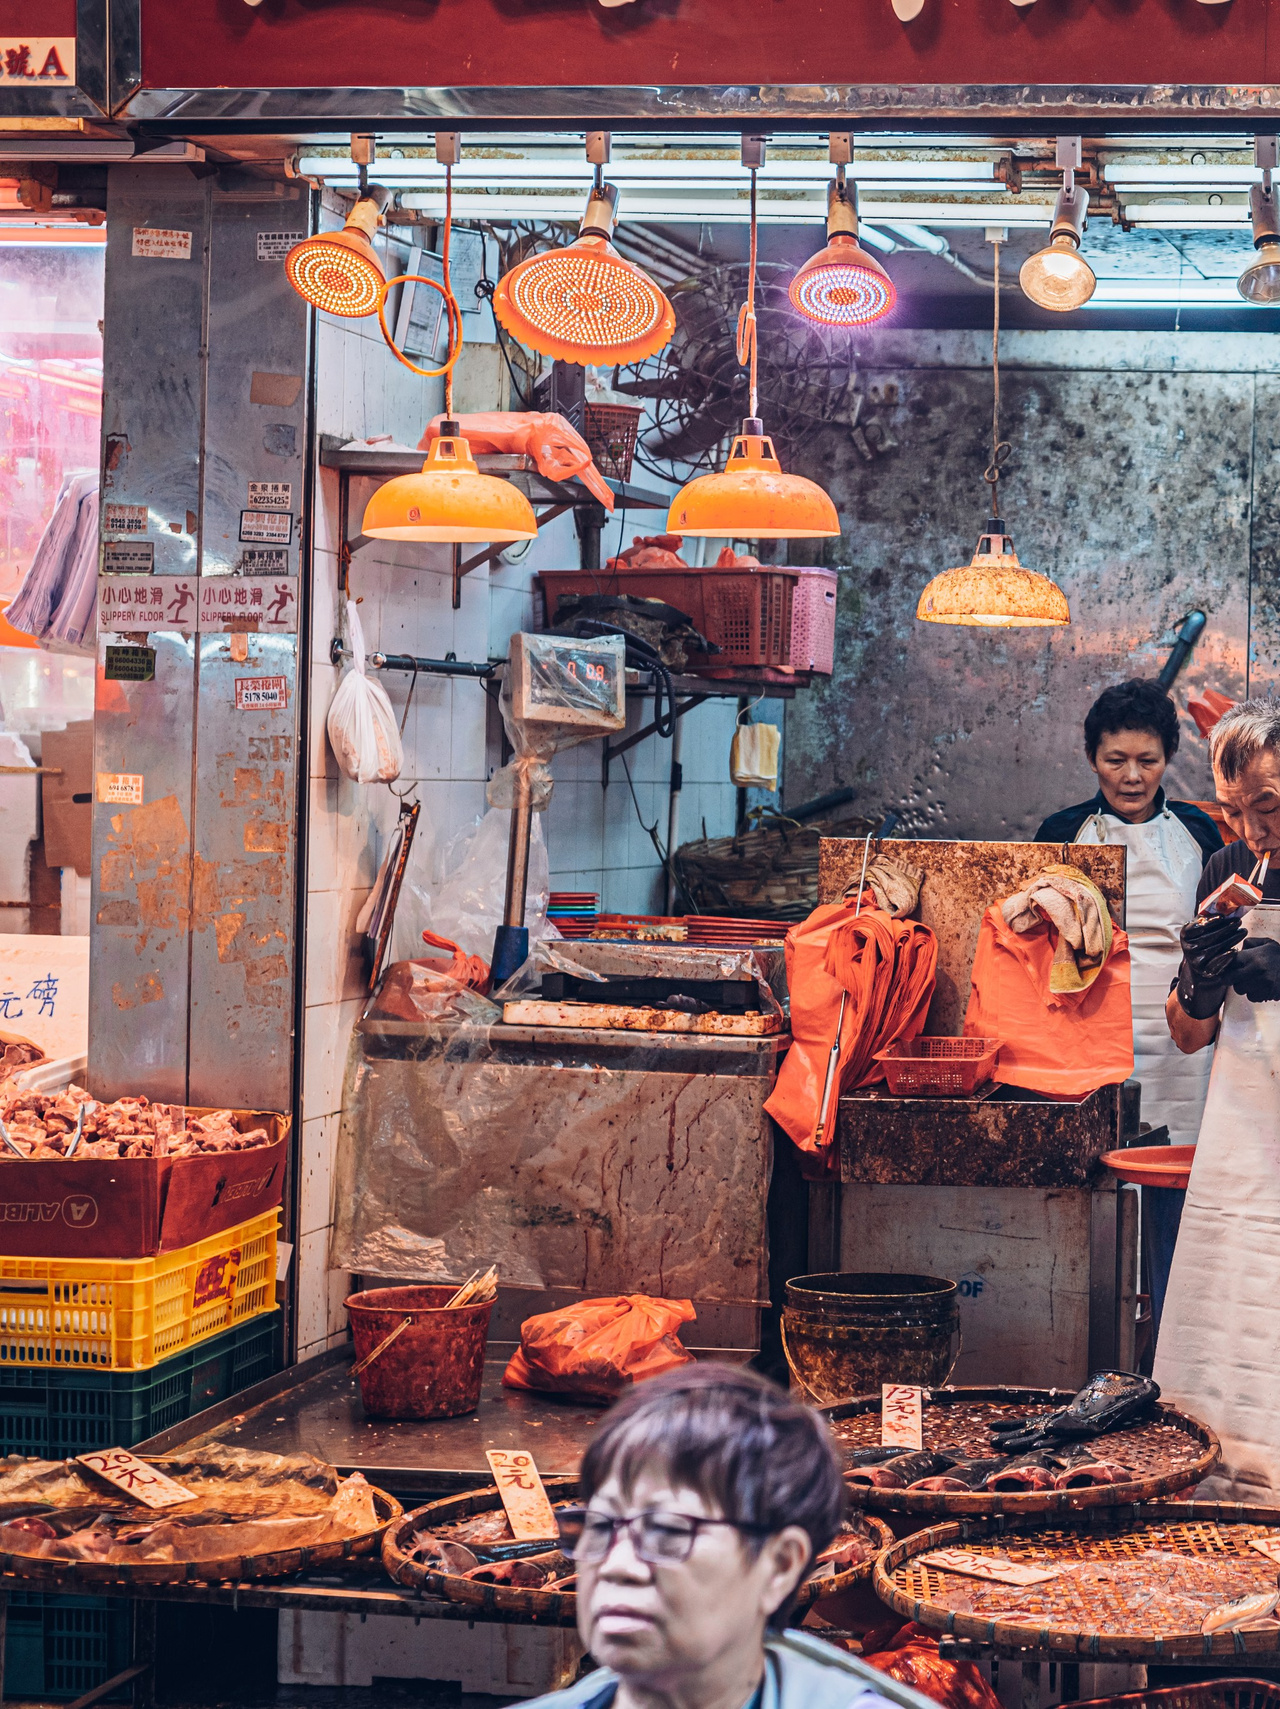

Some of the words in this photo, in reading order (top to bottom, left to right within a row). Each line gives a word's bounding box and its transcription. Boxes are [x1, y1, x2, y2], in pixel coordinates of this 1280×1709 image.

[102, 586, 163, 605] 小心地滑
[202, 587, 263, 606] 小心地滑
[101, 611, 136, 621] SLIPPERY
[140, 611, 164, 621] FLOOR
[885, 1387, 920, 1400] 15
[886, 1401, 915, 1415] 元
[84, 1454, 132, 1471] 20
[490, 1452, 530, 1468] 20
[115, 1468, 157, 1488] 元
[502, 1469, 535, 1490] 元
[970, 1562, 1012, 1575] 元
